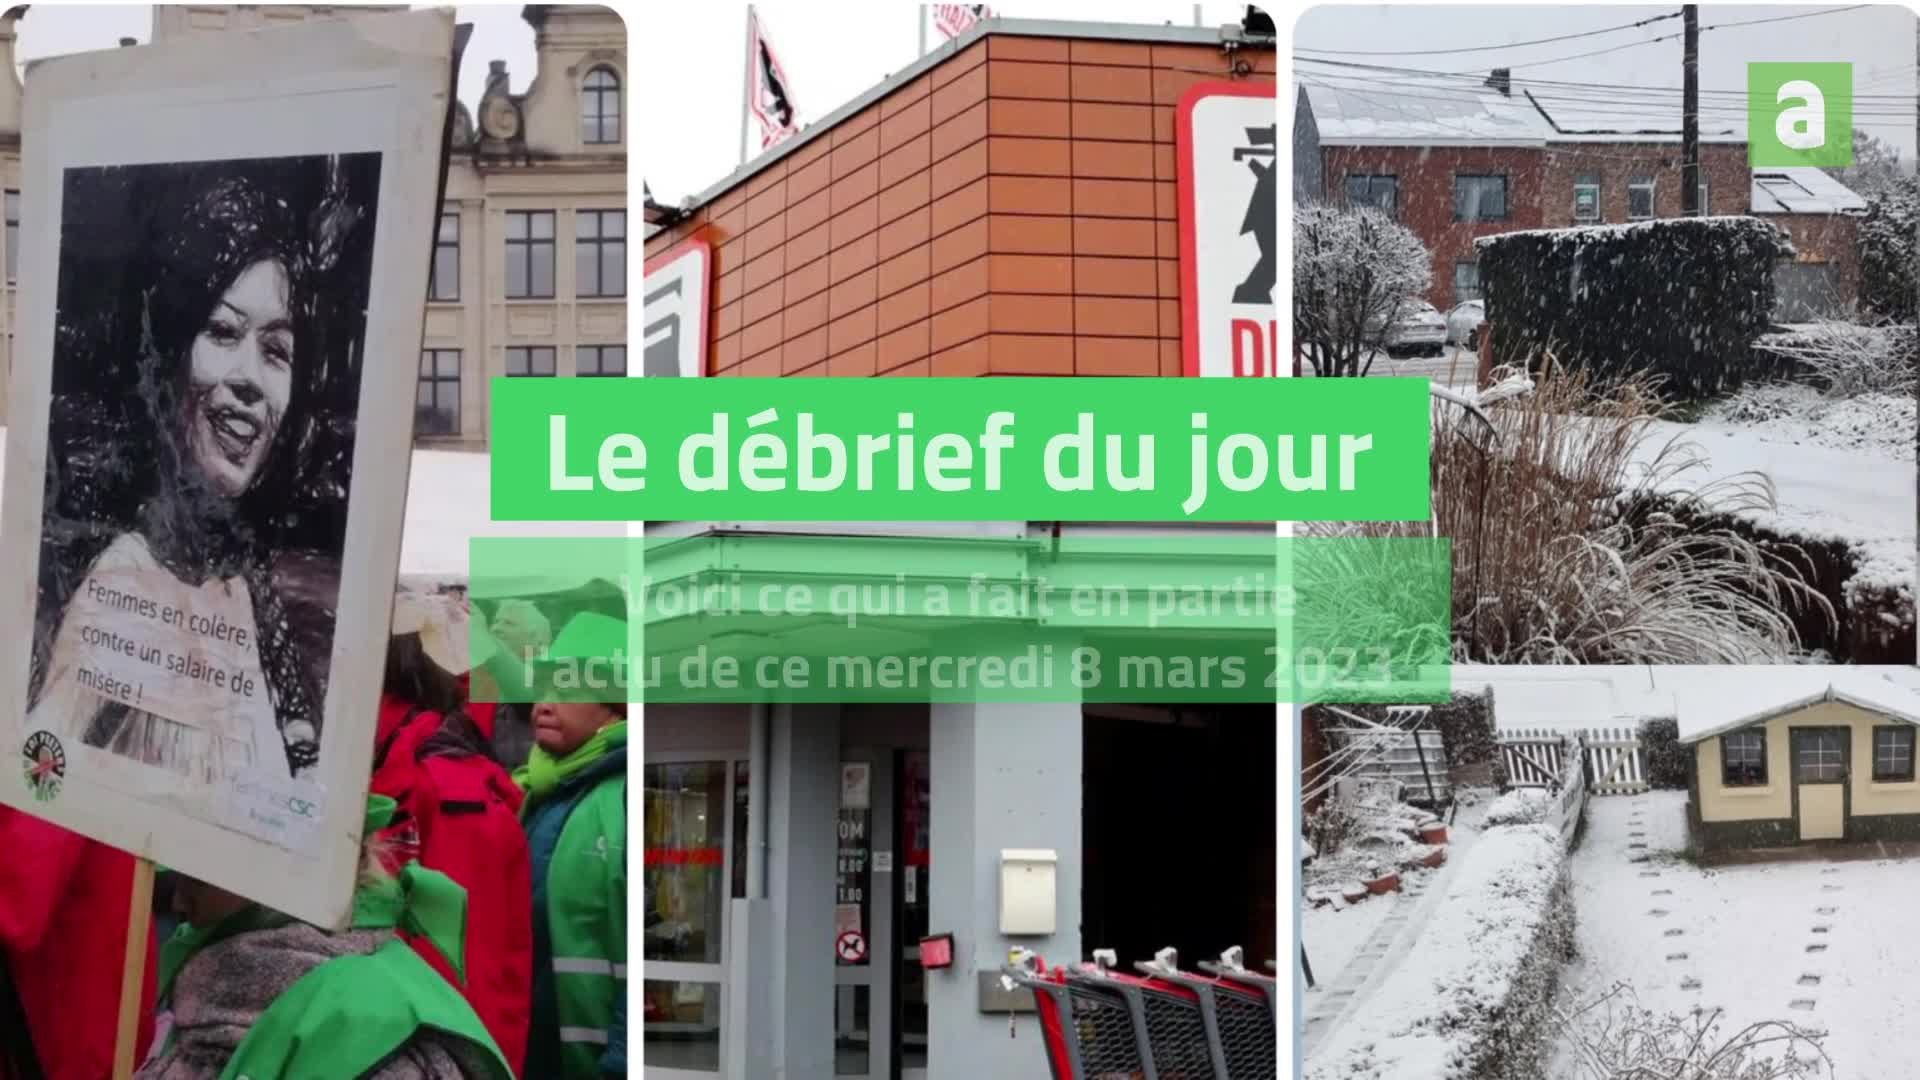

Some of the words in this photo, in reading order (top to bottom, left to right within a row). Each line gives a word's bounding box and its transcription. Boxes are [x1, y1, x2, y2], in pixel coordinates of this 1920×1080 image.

[1231, 319, 1277, 377] D
[87, 579, 158, 619] Femmes
[162, 605, 184, 626] en
[189, 613, 253, 652] colère,
[76, 668, 133, 702] misère
[135, 681, 143, 705] !
[81, 623, 135, 657] contre
[139, 645, 161, 667] un
[166, 652, 225, 688] salaire
[231, 670, 255, 697] de
